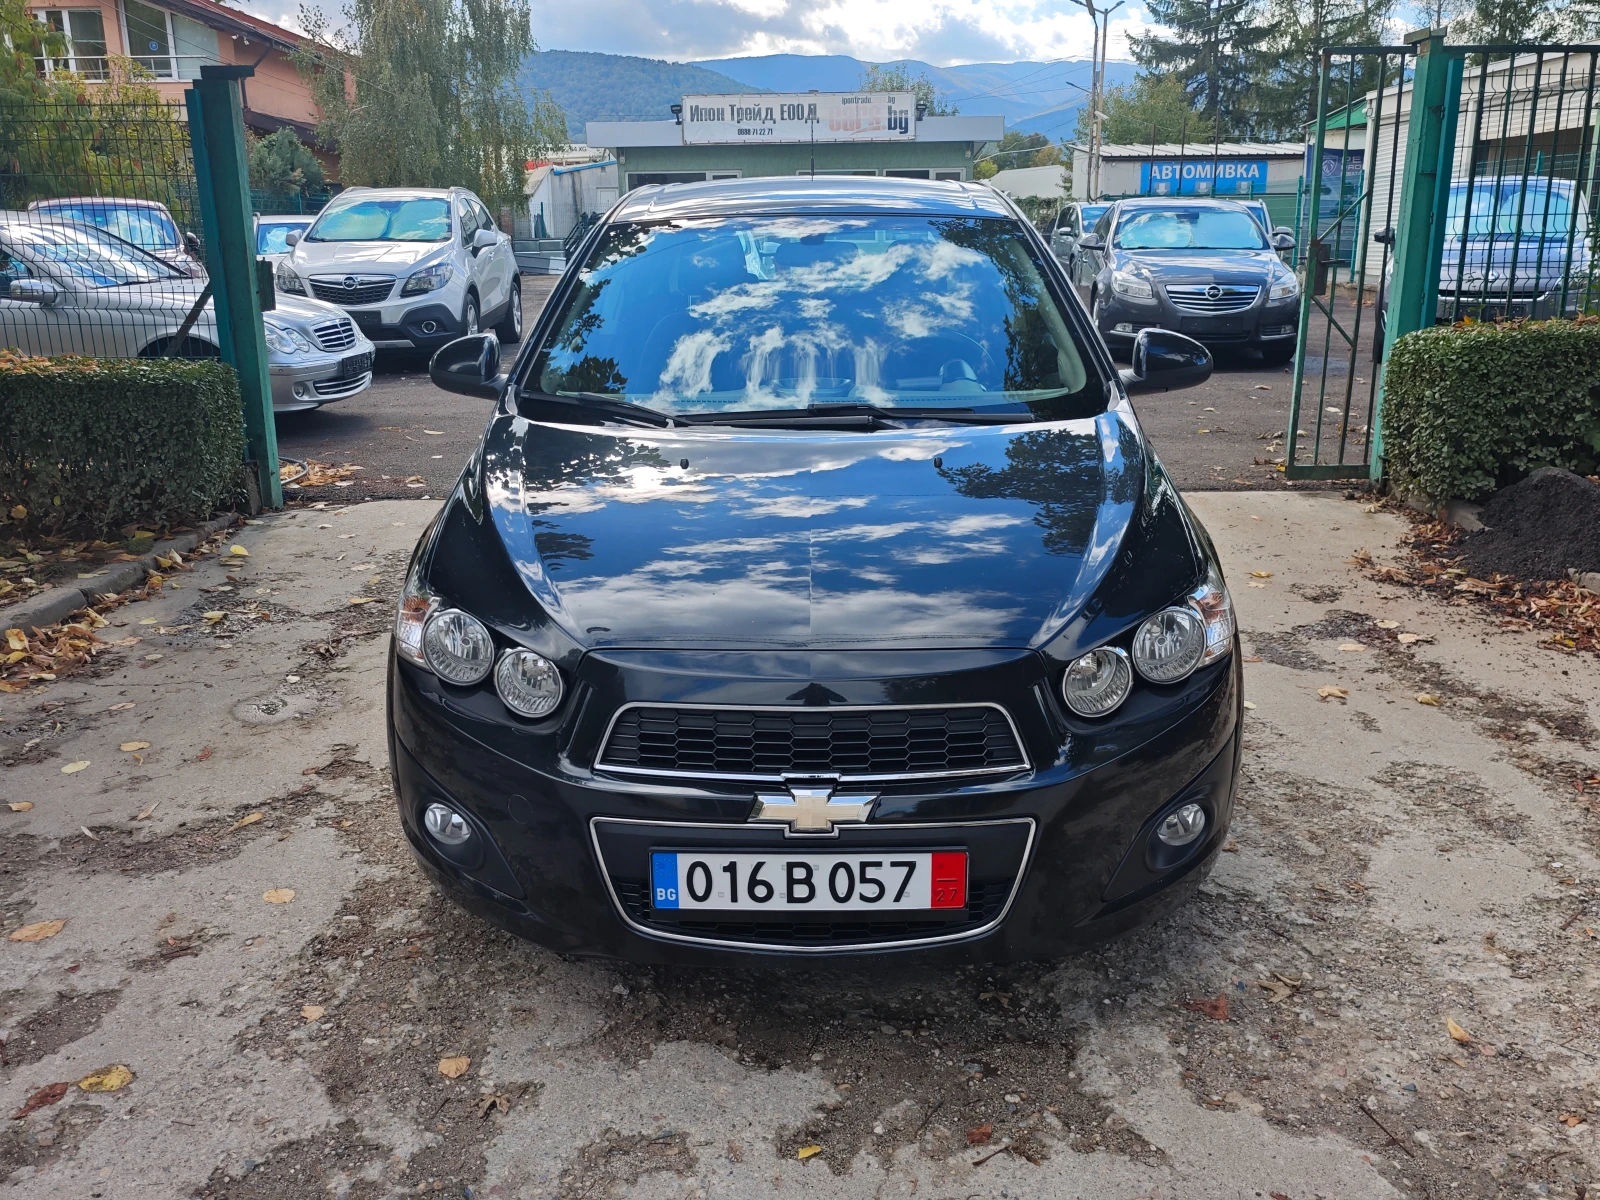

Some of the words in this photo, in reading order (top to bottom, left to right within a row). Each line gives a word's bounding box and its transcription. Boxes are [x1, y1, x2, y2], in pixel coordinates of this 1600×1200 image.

[690, 104, 725, 122] Ипон
[729, 103, 777, 124] Трейд
[780, 103, 820, 124] ЕООД
[752, 128, 758, 136] 71
[759, 128, 766, 136] 22
[767, 127, 773, 136] 71
[1151, 164, 1260, 180] АВТОМИВКА
[656, 887, 677, 901] BG
[936, 888, 958, 902] 27
